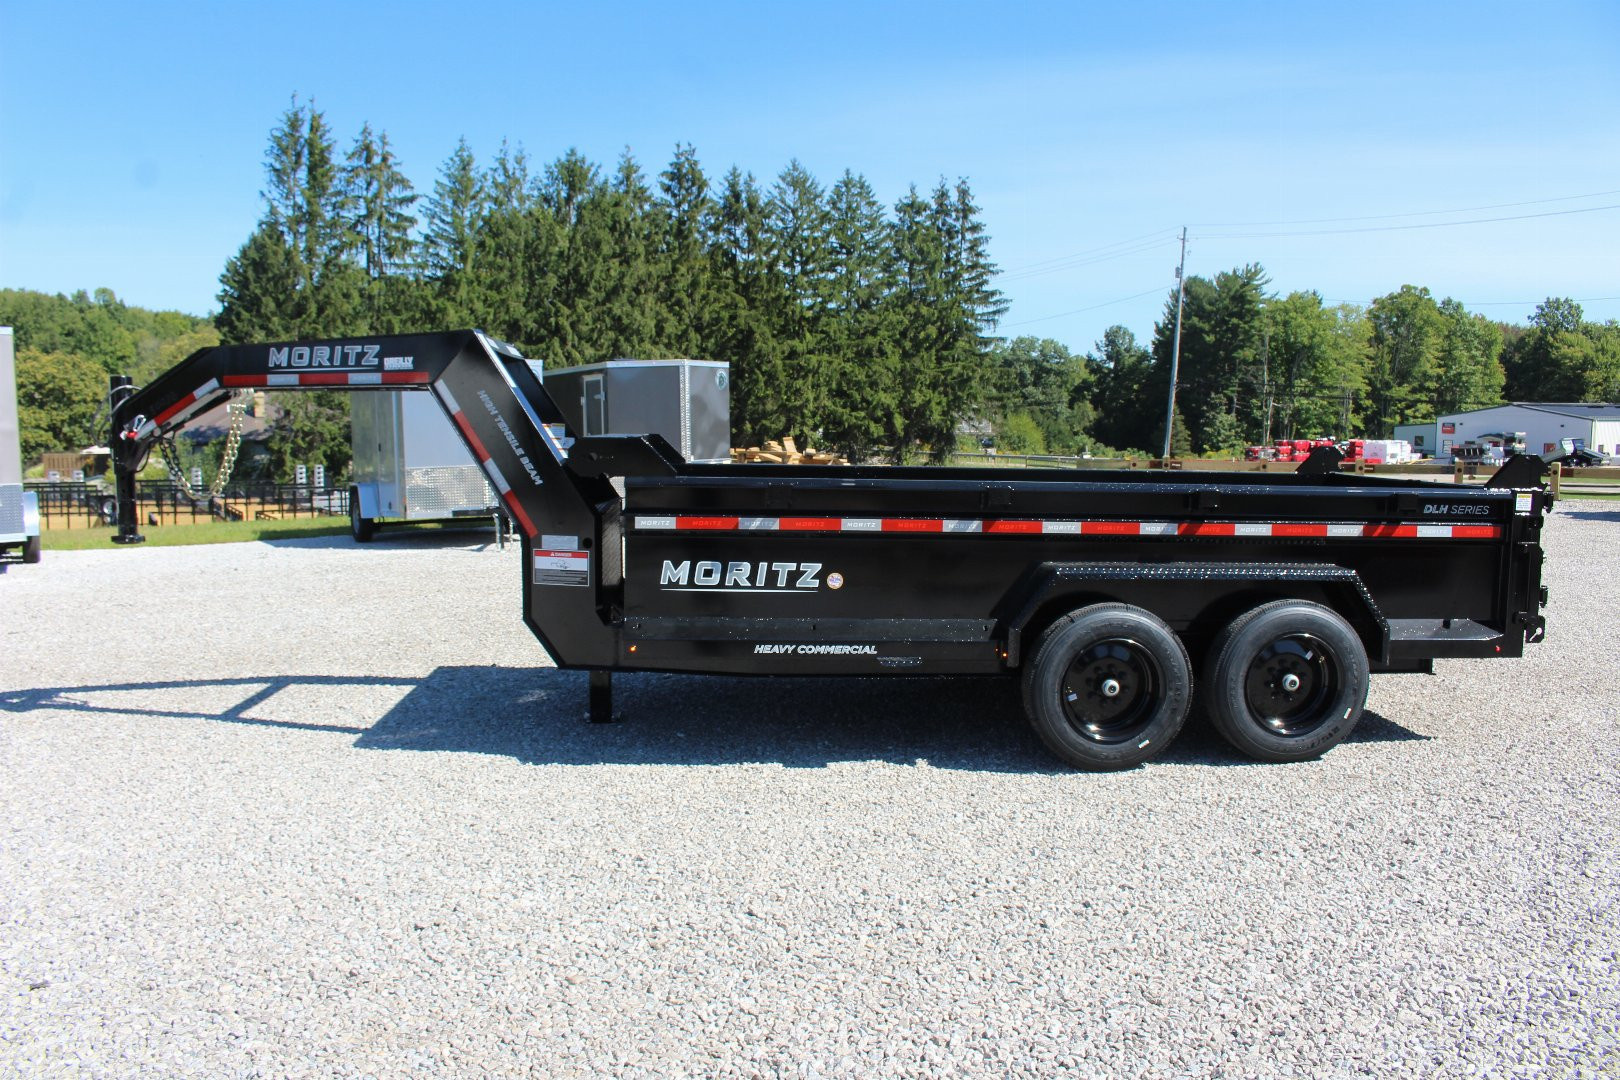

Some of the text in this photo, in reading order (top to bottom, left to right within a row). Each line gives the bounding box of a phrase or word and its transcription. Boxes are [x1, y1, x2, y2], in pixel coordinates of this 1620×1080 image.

[268, 345, 381, 368] MORITZ
[477, 389, 499, 416] HIGH
[495, 414, 525, 456] TENSILE
[519, 456, 543, 485] BEAM
[1423, 504, 1490, 515] DLH SERIES
[660, 560, 823, 588] MORITZ
[753, 644, 878, 655] HEAVY COMMERCIAL
